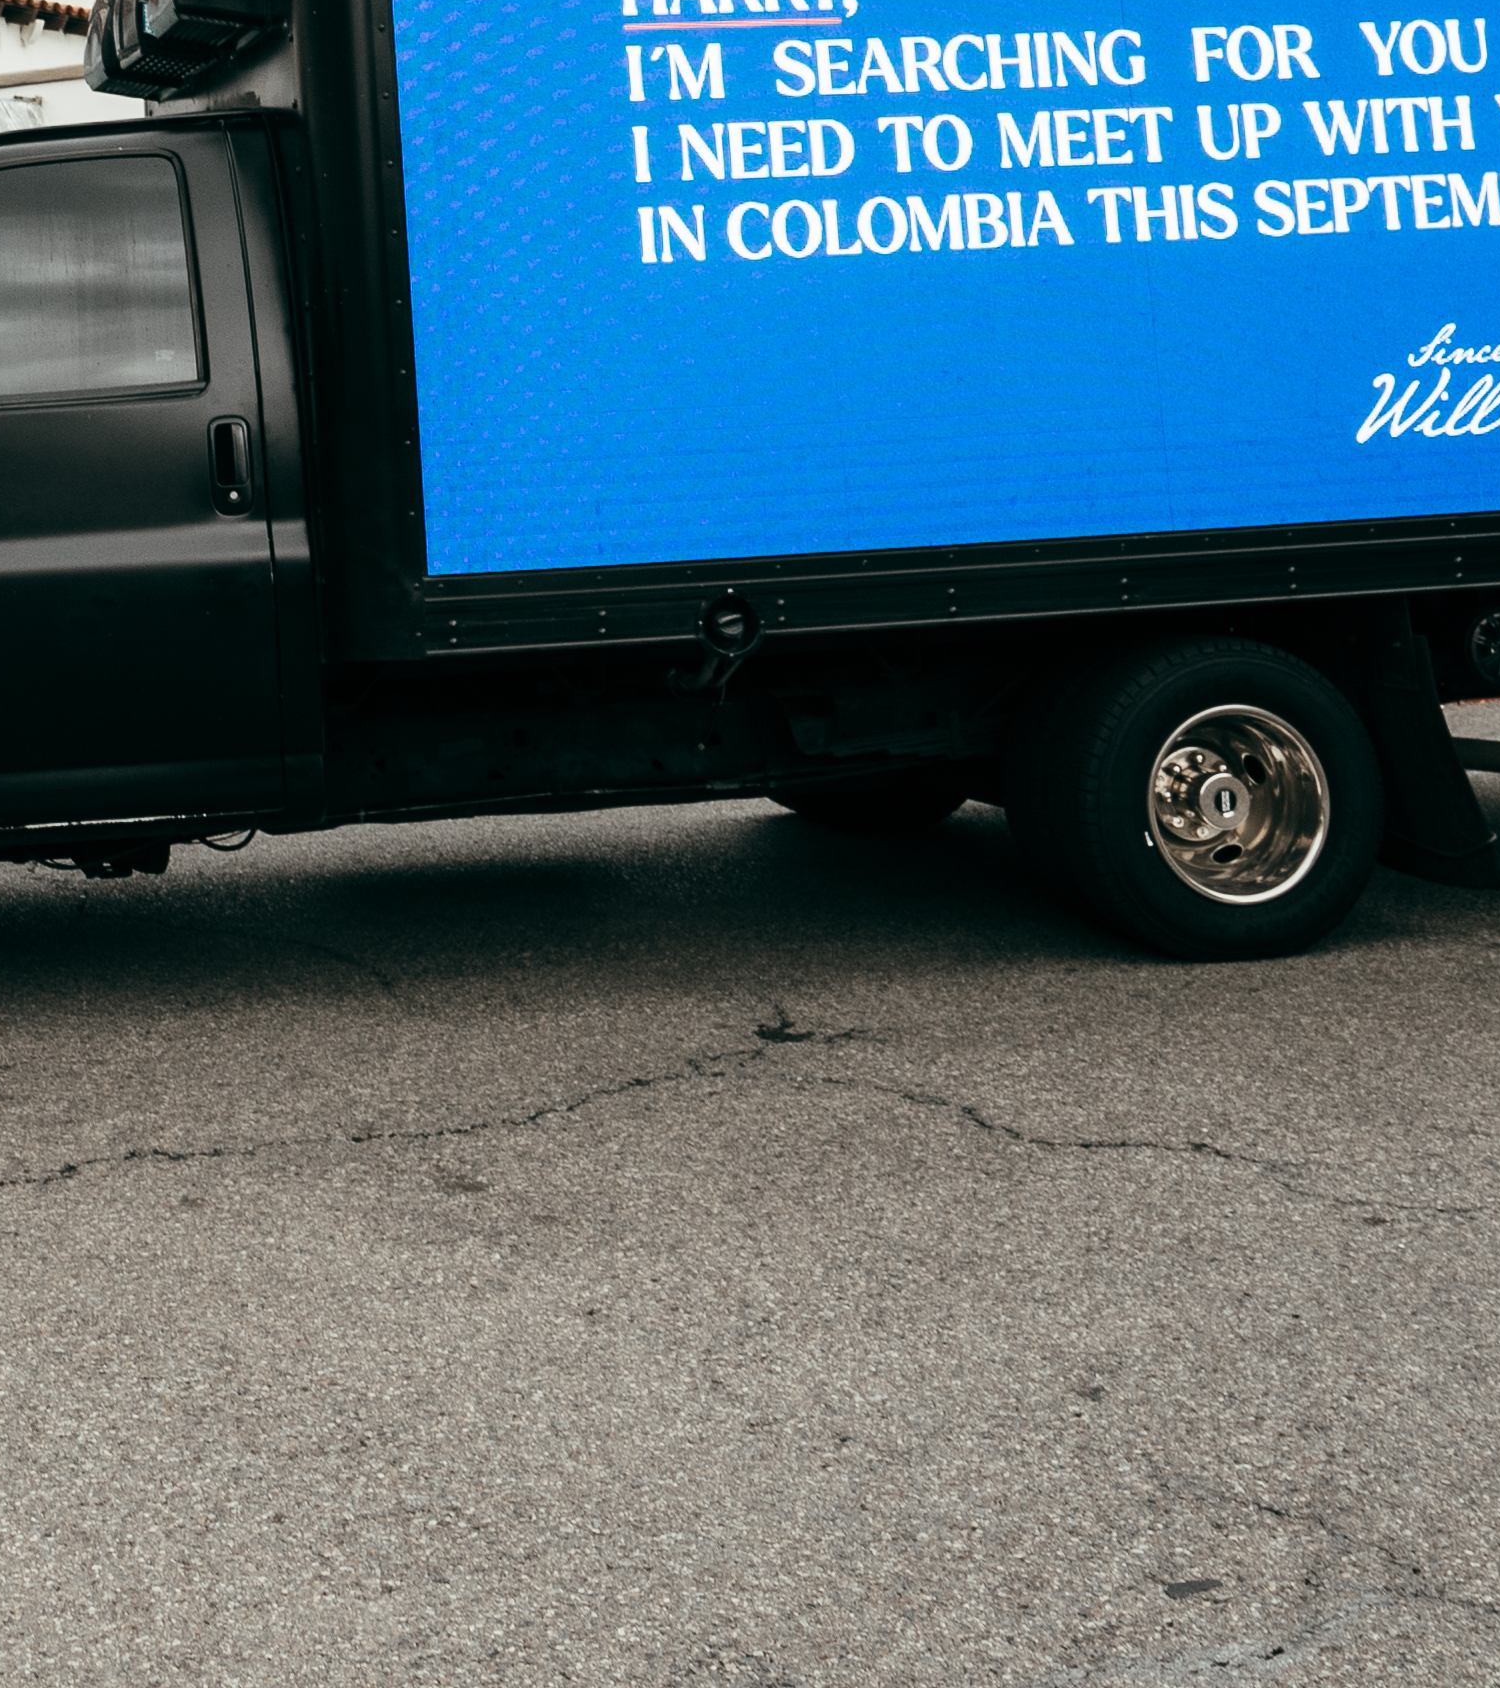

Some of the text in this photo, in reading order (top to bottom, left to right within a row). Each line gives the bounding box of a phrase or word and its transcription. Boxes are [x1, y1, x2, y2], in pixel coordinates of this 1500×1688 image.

[626, 43, 726, 102] I'M
[772, 29, 1147, 97] SEARCHING
[1191, 25, 1320, 82] FOR
[1359, 17, 1488, 76] YOU
[632, 125, 652, 183] I
[678, 120, 855, 181] NEED
[878, 114, 973, 173] TO
[997, 107, 1173, 169] MEET
[1197, 103, 1282, 160] UP
[1303, 95, 1476, 155] WITH
[638, 205, 707, 263] IN
[727, 191, 1075, 261] COLOMBIA
[1086, 182, 1239, 243] THIS
